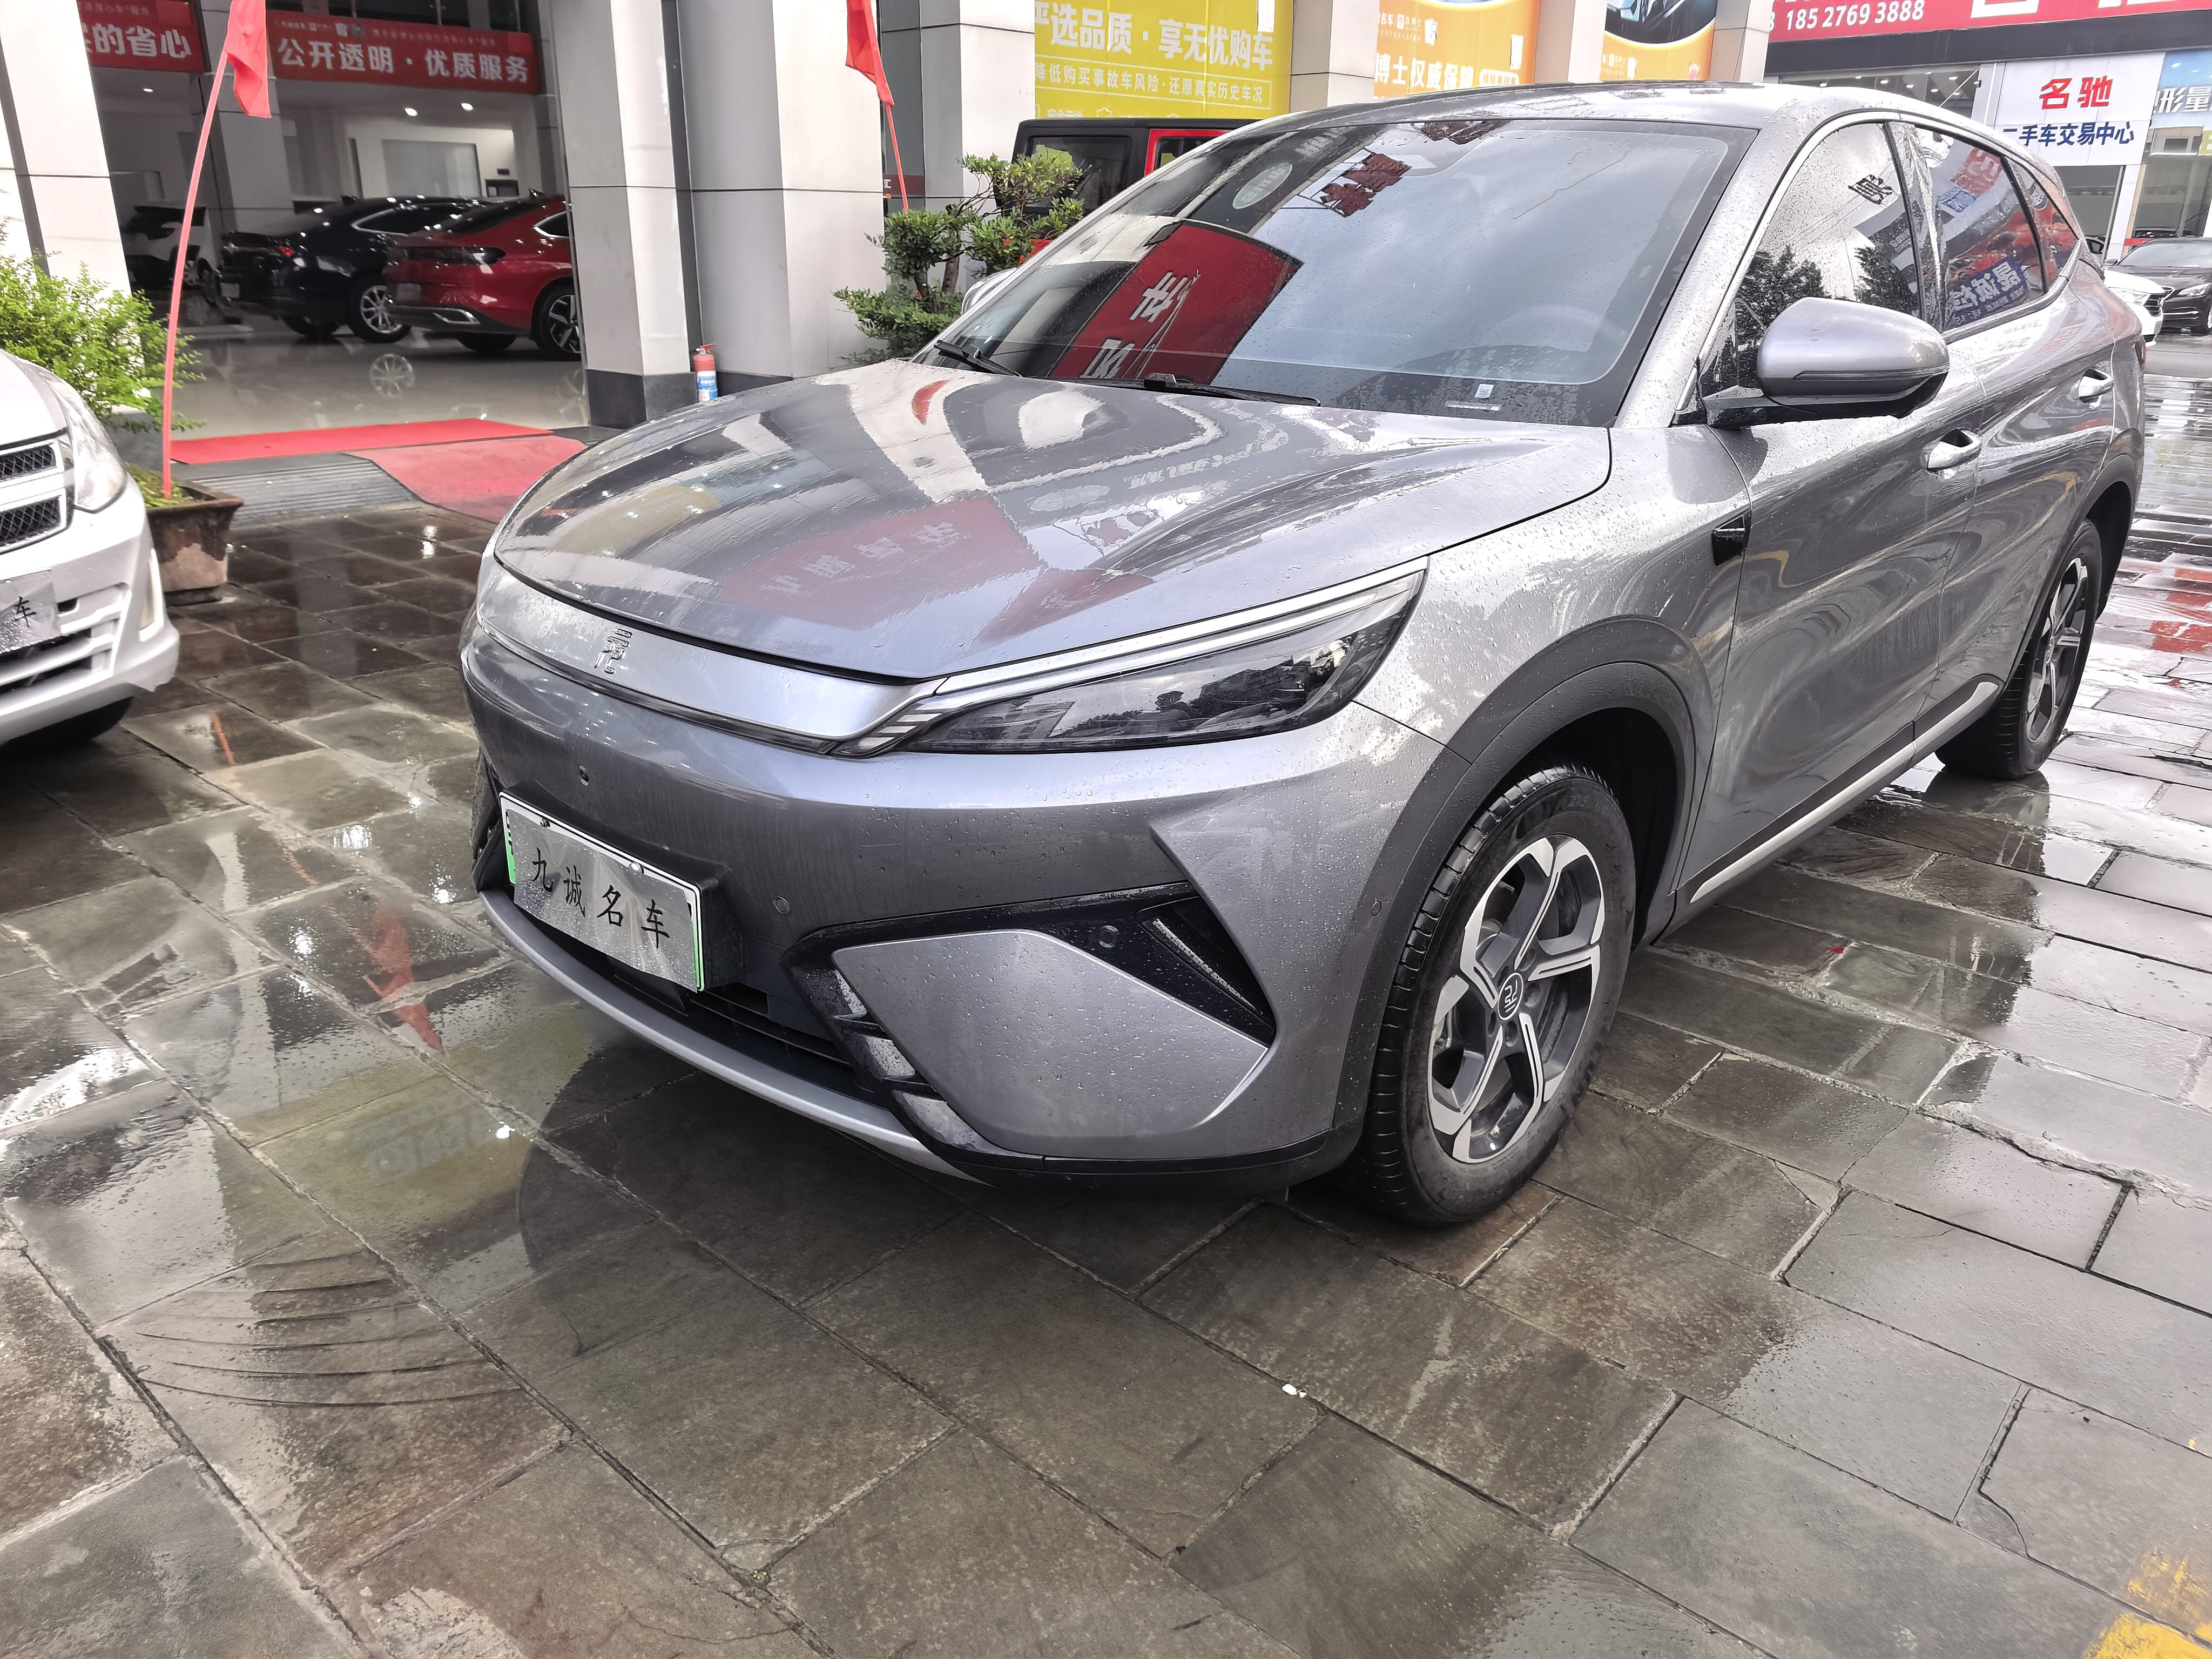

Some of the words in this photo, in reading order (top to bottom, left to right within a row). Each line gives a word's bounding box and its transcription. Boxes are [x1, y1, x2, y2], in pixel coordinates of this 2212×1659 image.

[1786, 8, 1818, 30] 185
[1822, 3, 1870, 26] 2769
[1876, 0, 1924, 23] 3888
[2039, 76, 2114, 110] 名驰
[2153, 85, 2212, 113] 形量
[14, 596, 37, 628] 车
[532, 847, 670, 949] 九诚名车
